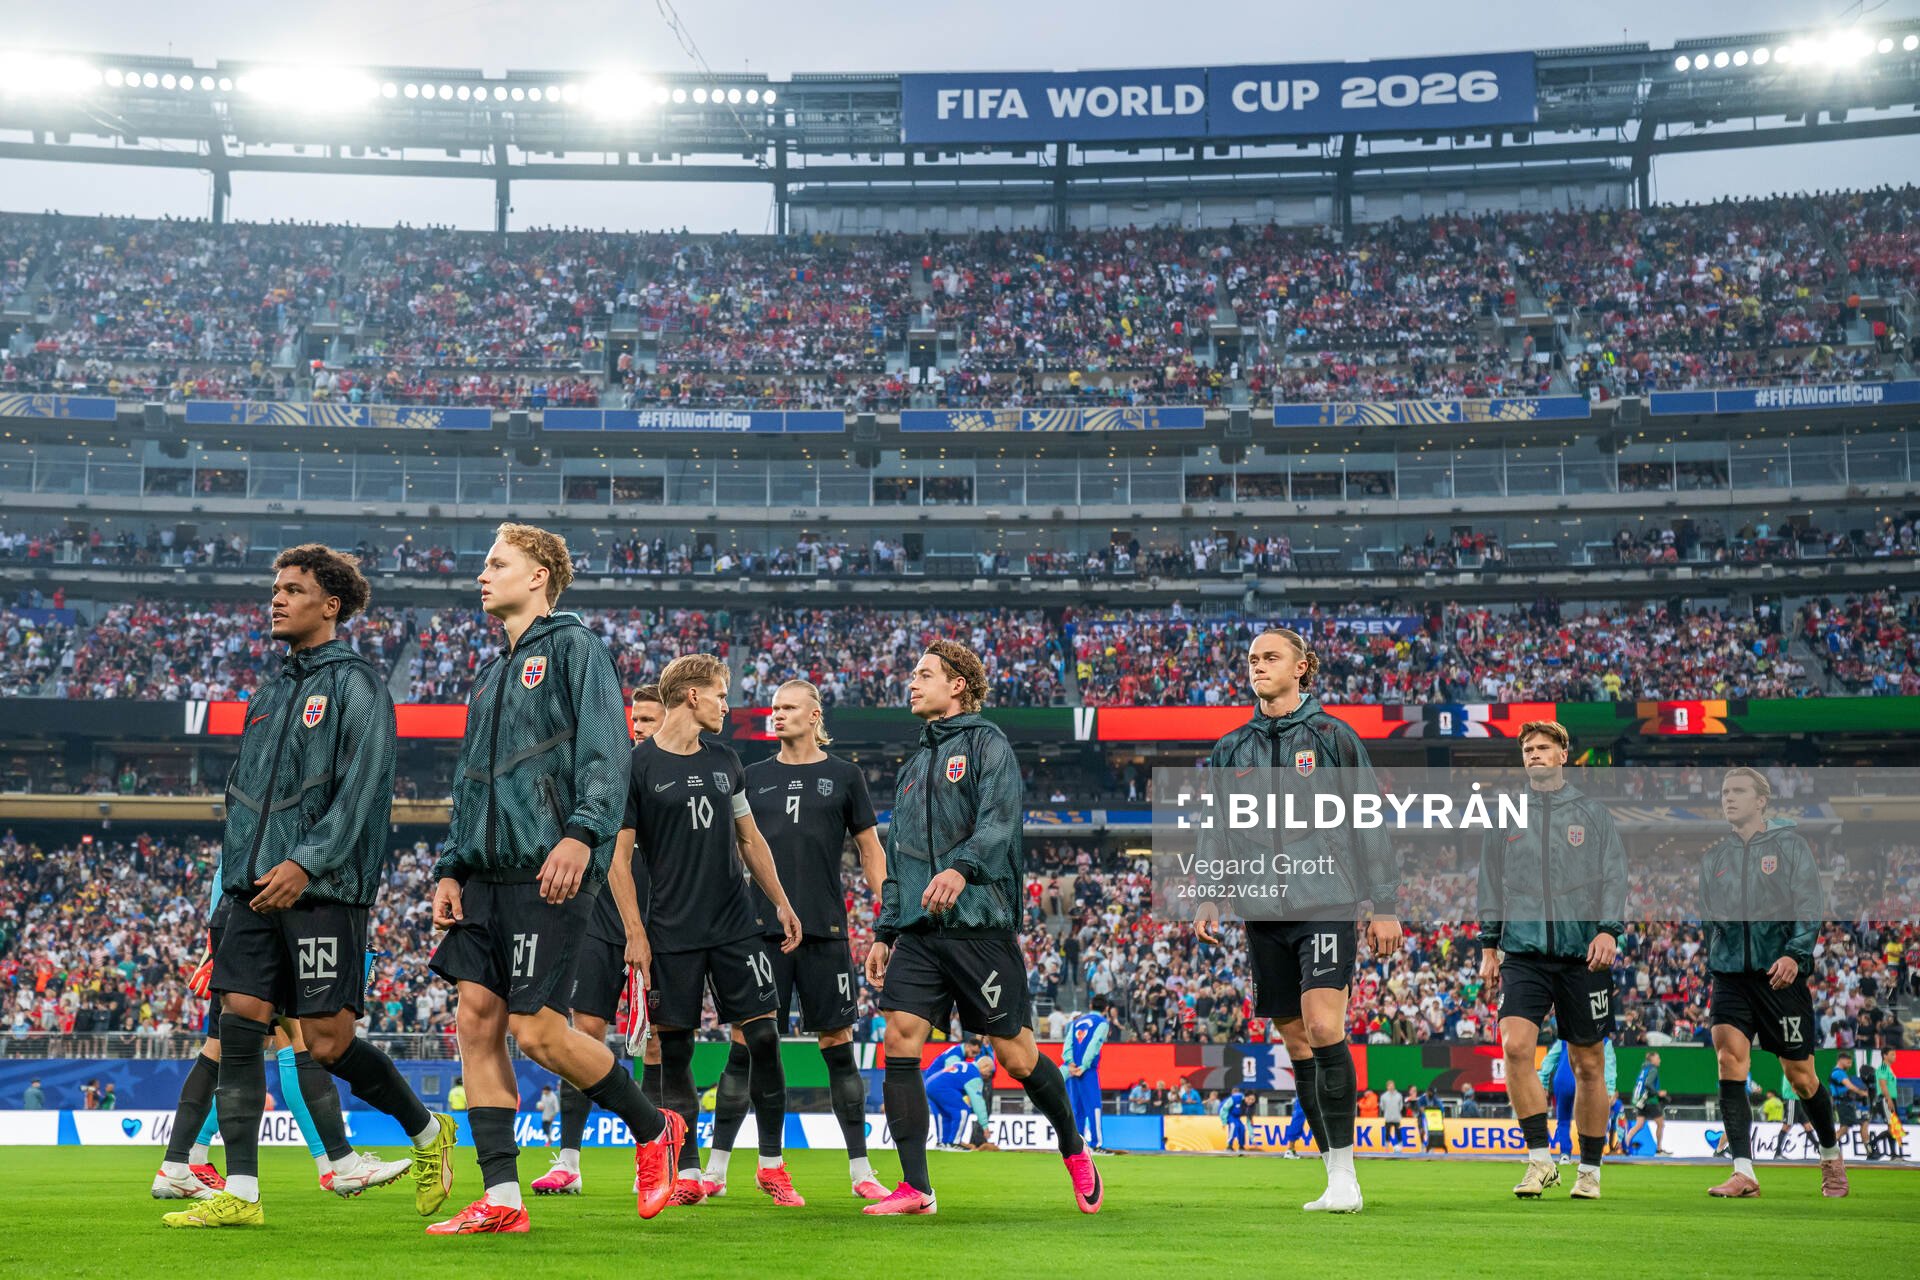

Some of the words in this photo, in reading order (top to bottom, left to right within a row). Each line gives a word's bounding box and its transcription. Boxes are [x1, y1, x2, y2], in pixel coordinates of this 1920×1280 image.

[937, 88, 1028, 119] FIFA
[1046, 84, 1205, 118] WORLD
[1232, 80, 1320, 112] CUP
[1341, 70, 1499, 109] 2026
[1755, 386, 1883, 407] #FIFAWorldCup
[638, 411, 751, 431] #FIFAWorldCup
[687, 796, 714, 829] 10
[786, 795, 800, 823] 9
[298, 937, 338, 979] 22
[512, 933, 538, 977] 21
[1311, 933, 1338, 963] 19
[746, 951, 772, 987] 10
[837, 973, 851, 1001] 9
[980, 970, 1001, 1008] 6
[1779, 1016, 1803, 1042] 18
[261, 1116, 298, 1141] ACE
[598, 1117, 636, 1144] PEA
[1452, 1127, 1561, 1149] JERSY
